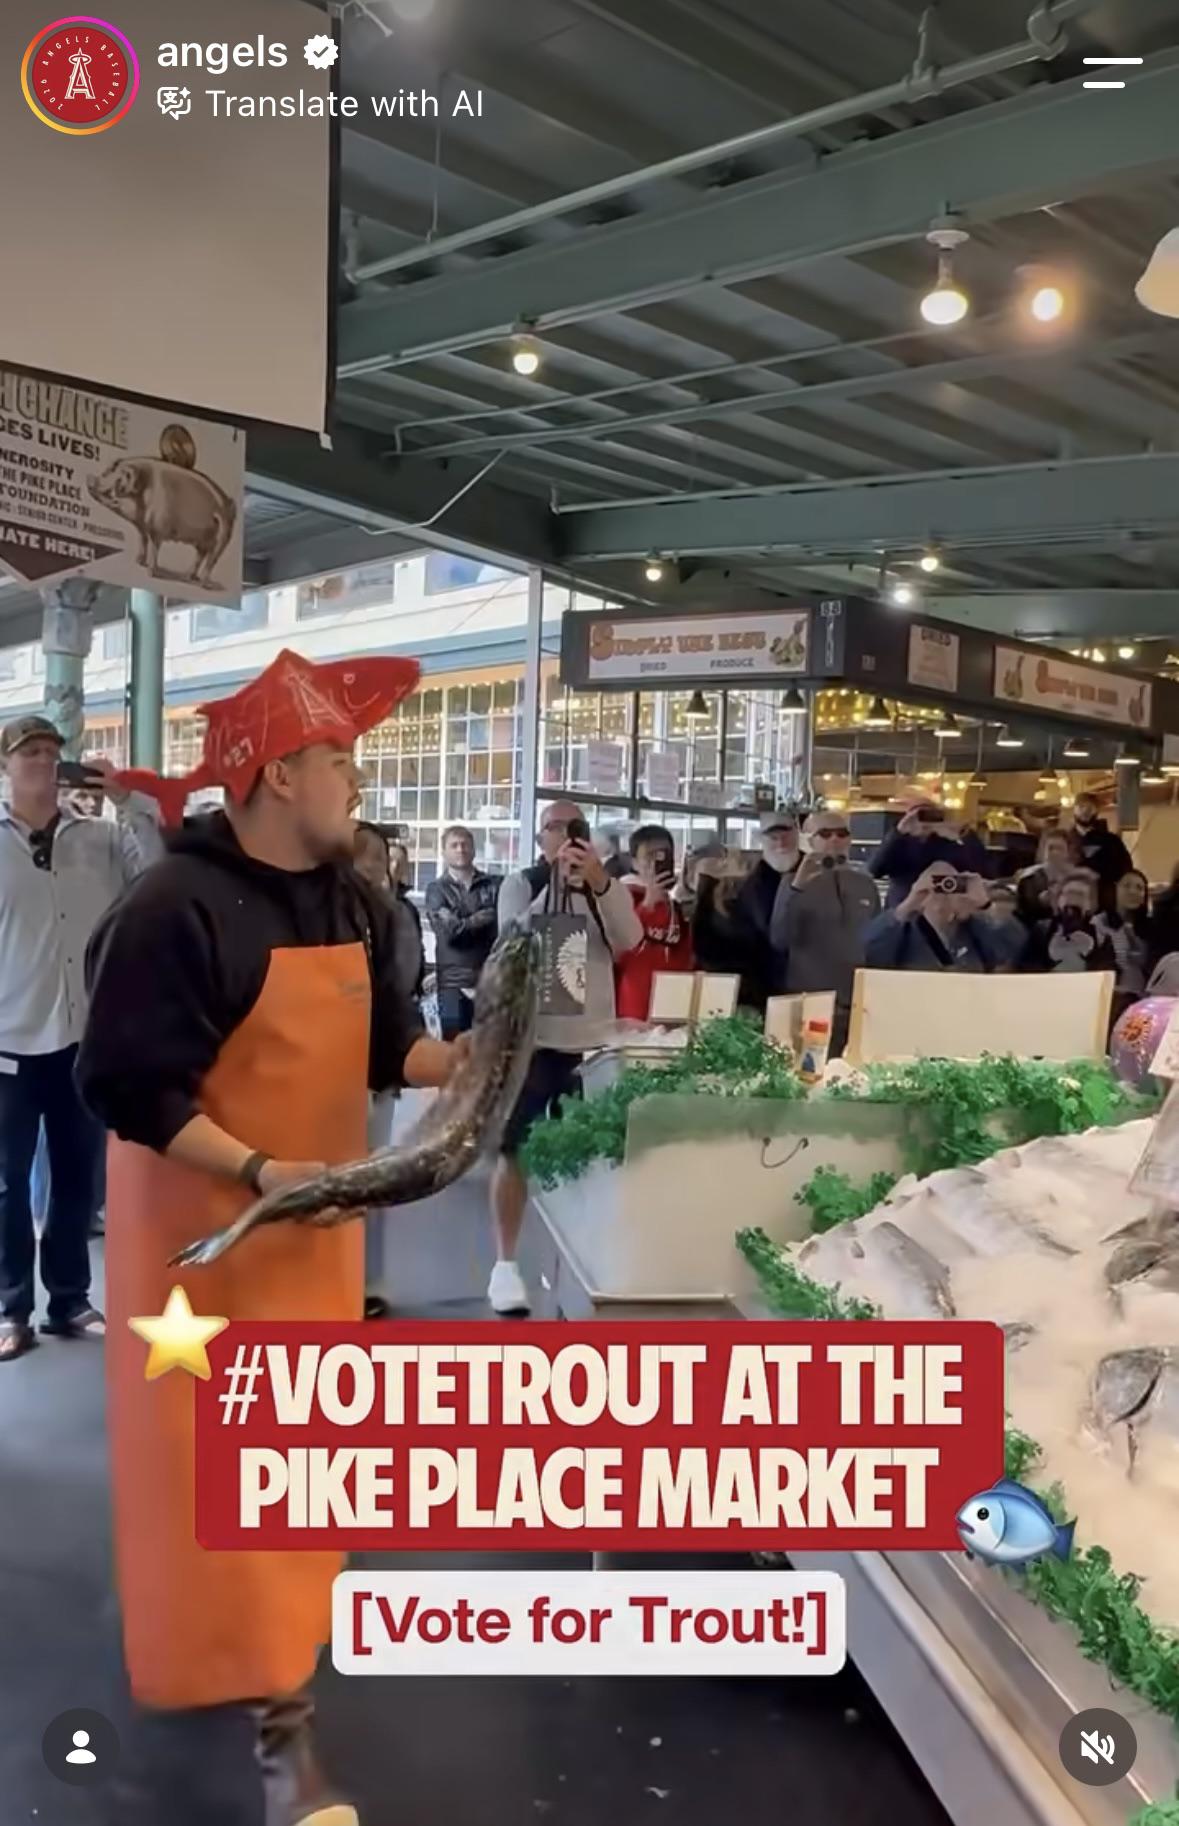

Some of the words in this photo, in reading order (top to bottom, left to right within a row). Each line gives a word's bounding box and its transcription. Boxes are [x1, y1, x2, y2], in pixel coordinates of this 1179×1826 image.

[17, 377, 128, 450] CHANGE
[38, 428, 100, 461] LIVES!
[20, 471, 45, 490] PIKE
[48, 479, 82, 501] PLACE
[44, 537, 95, 560] HERE!
[710, 657, 754, 669] PRODUCE
